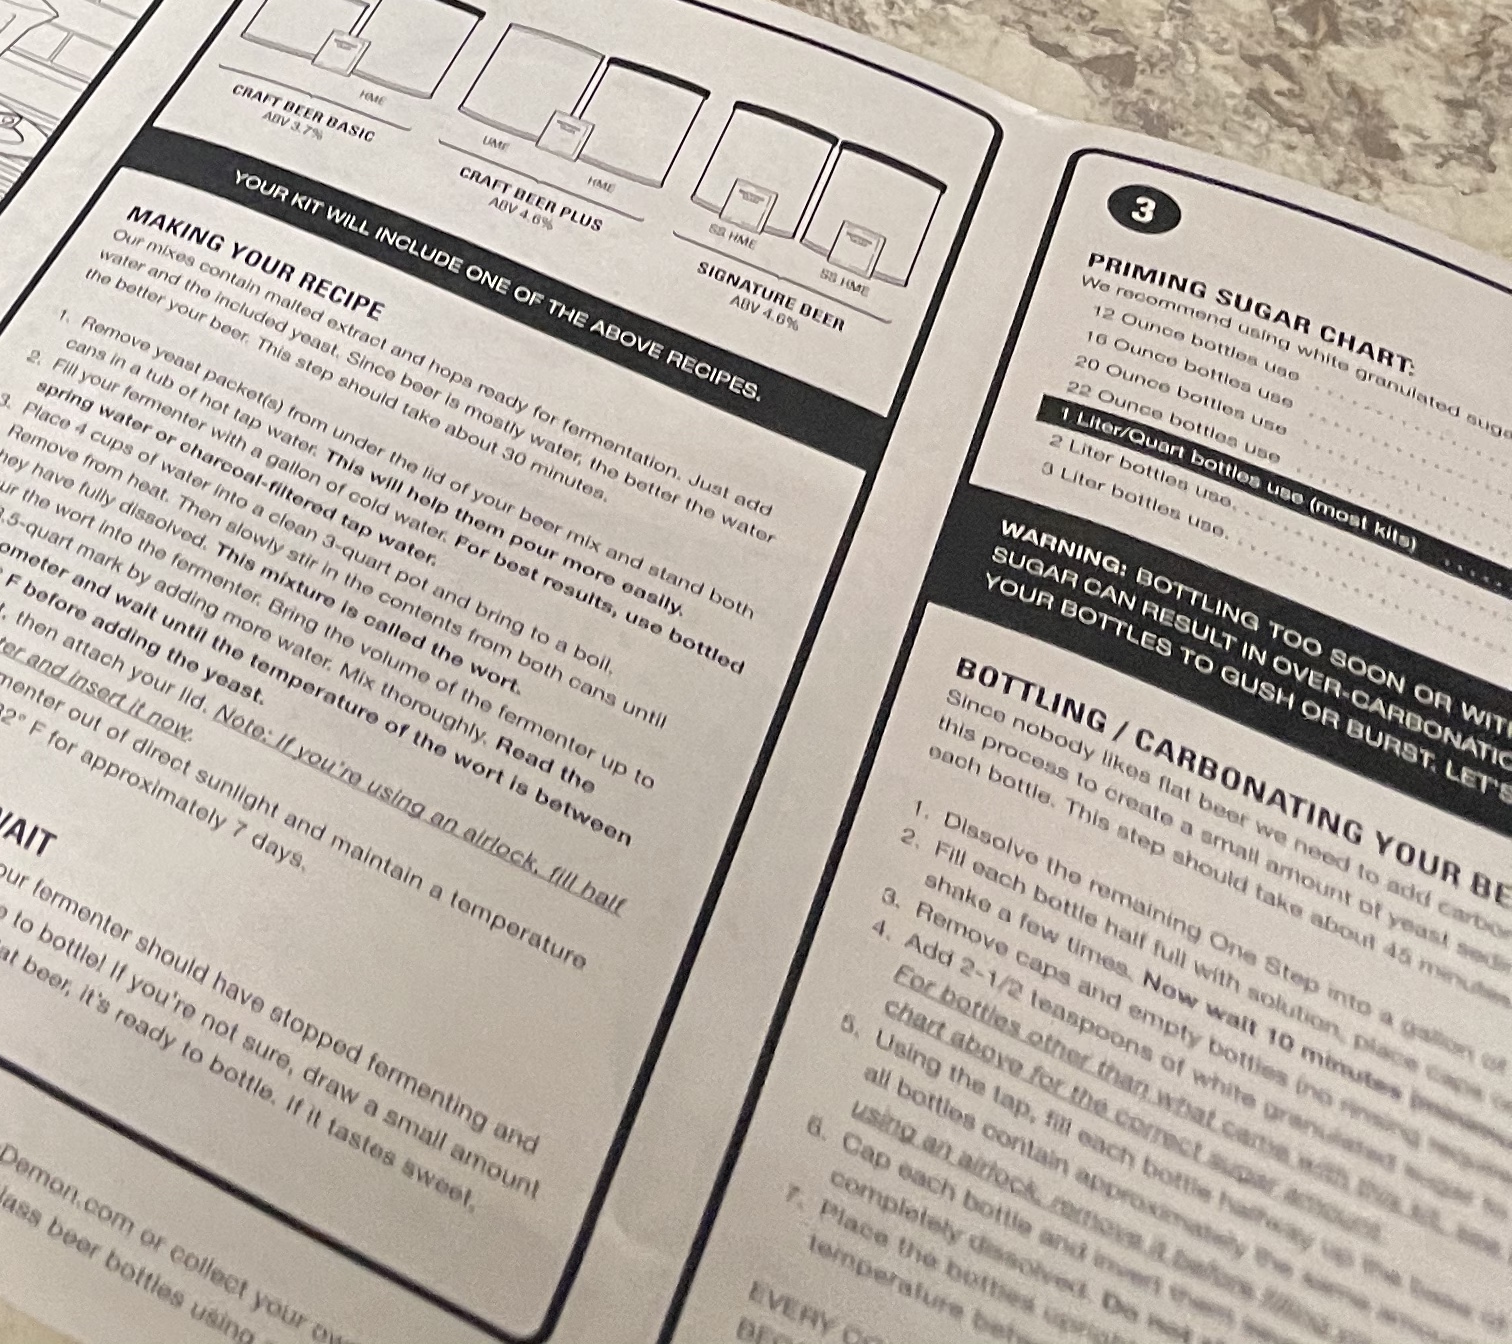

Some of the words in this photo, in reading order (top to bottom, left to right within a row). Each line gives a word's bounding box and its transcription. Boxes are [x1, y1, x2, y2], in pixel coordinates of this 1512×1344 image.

[232, 84, 282, 107] CRAFT
[282, 100, 324, 123] BEER
[325, 115, 375, 142] BASIC
[261, 110, 291, 127] ABV
[289, 120, 322, 140] 3.7%
[459, 166, 512, 194] CRAFT
[512, 186, 557, 213] BEER
[559, 205, 603, 231] PLUS
[487, 196, 518, 214] ABV
[518, 208, 553, 230] 4.6%
[1131, 196, 1156, 224] 3
[127, 205, 224, 252] MAKING
[230, 245, 292, 282] YOUR
[304, 271, 385, 321] RECIPE
[235, 168, 289, 202] YOUR
[290, 194, 325, 214] KIT
[326, 205, 369, 236] WILL
[374, 226, 464, 273] INCLUDE
[466, 264, 511, 294] ONE
[515, 285, 544, 305] OF
[549, 298, 588, 328] THE
[591, 319, 664, 359] ABOVE
[665, 349, 760, 402] RECIPES.
[696, 261, 796, 310] SIGNATURE
[801, 303, 845, 332] BEER
[728, 294, 761, 314] ABV
[762, 307, 798, 331] 4.6%
[1087, 251, 1207, 298] PRIMING
[1214, 288, 1311, 334] SUGAR
[1321, 324, 1414, 376] CHART:
[1081, 273, 1110, 292] We
[1115, 286, 1232, 329] recommend
[1237, 323, 1290, 352] using
[1296, 344, 1349, 371] white
[1355, 367, 1460, 417] granulated
[1094, 305, 1115, 320] 12
[1120, 312, 1185, 341] Ounce
[1190, 331, 1257, 366] bottles
[1263, 360, 1299, 381] use
[1061, 406, 1069, 420] 1
[1076, 410, 1184, 459] Liter/Quart
[1190, 448, 1260, 488] bottles
[1266, 481, 1303, 504] use
[1310, 495, 1367, 530] (most
[1373, 520, 1416, 553] kits)
[4, 572, 22, 587] F
[22, 579, 87, 620] before
[90, 615, 161, 658] adding
[166, 646, 199, 672] the
[200, 666, 263, 705] yeast.
[992, 545, 1078, 589] SUGAR
[1084, 577, 1136, 611] CAN
[1142, 599, 1237, 651] RESULT
[1241, 640, 1267, 666] IN
[1002, 518, 1127, 577] WARNING:
[1136, 566, 1259, 631] BOTTLING
[1268, 620, 1322, 656] TOO
[1329, 647, 1405, 694] SOON
[1414, 684, 1451, 713] OR
[1461, 701, 1512, 739] WIT
[985, 571, 1054, 610] YOUR
[1060, 598, 1172, 656] BOTTLES
[1179, 645, 1214, 674] TO
[1221, 665, 1294, 710] GUSH
[1301, 699, 1340, 730] OR
[1345, 717, 1435, 772] BURST.
[955, 656, 1107, 733] BOTTLING
[1134, 727, 1363, 845] CARBONATING
[1375, 829, 1461, 887] YOUR
